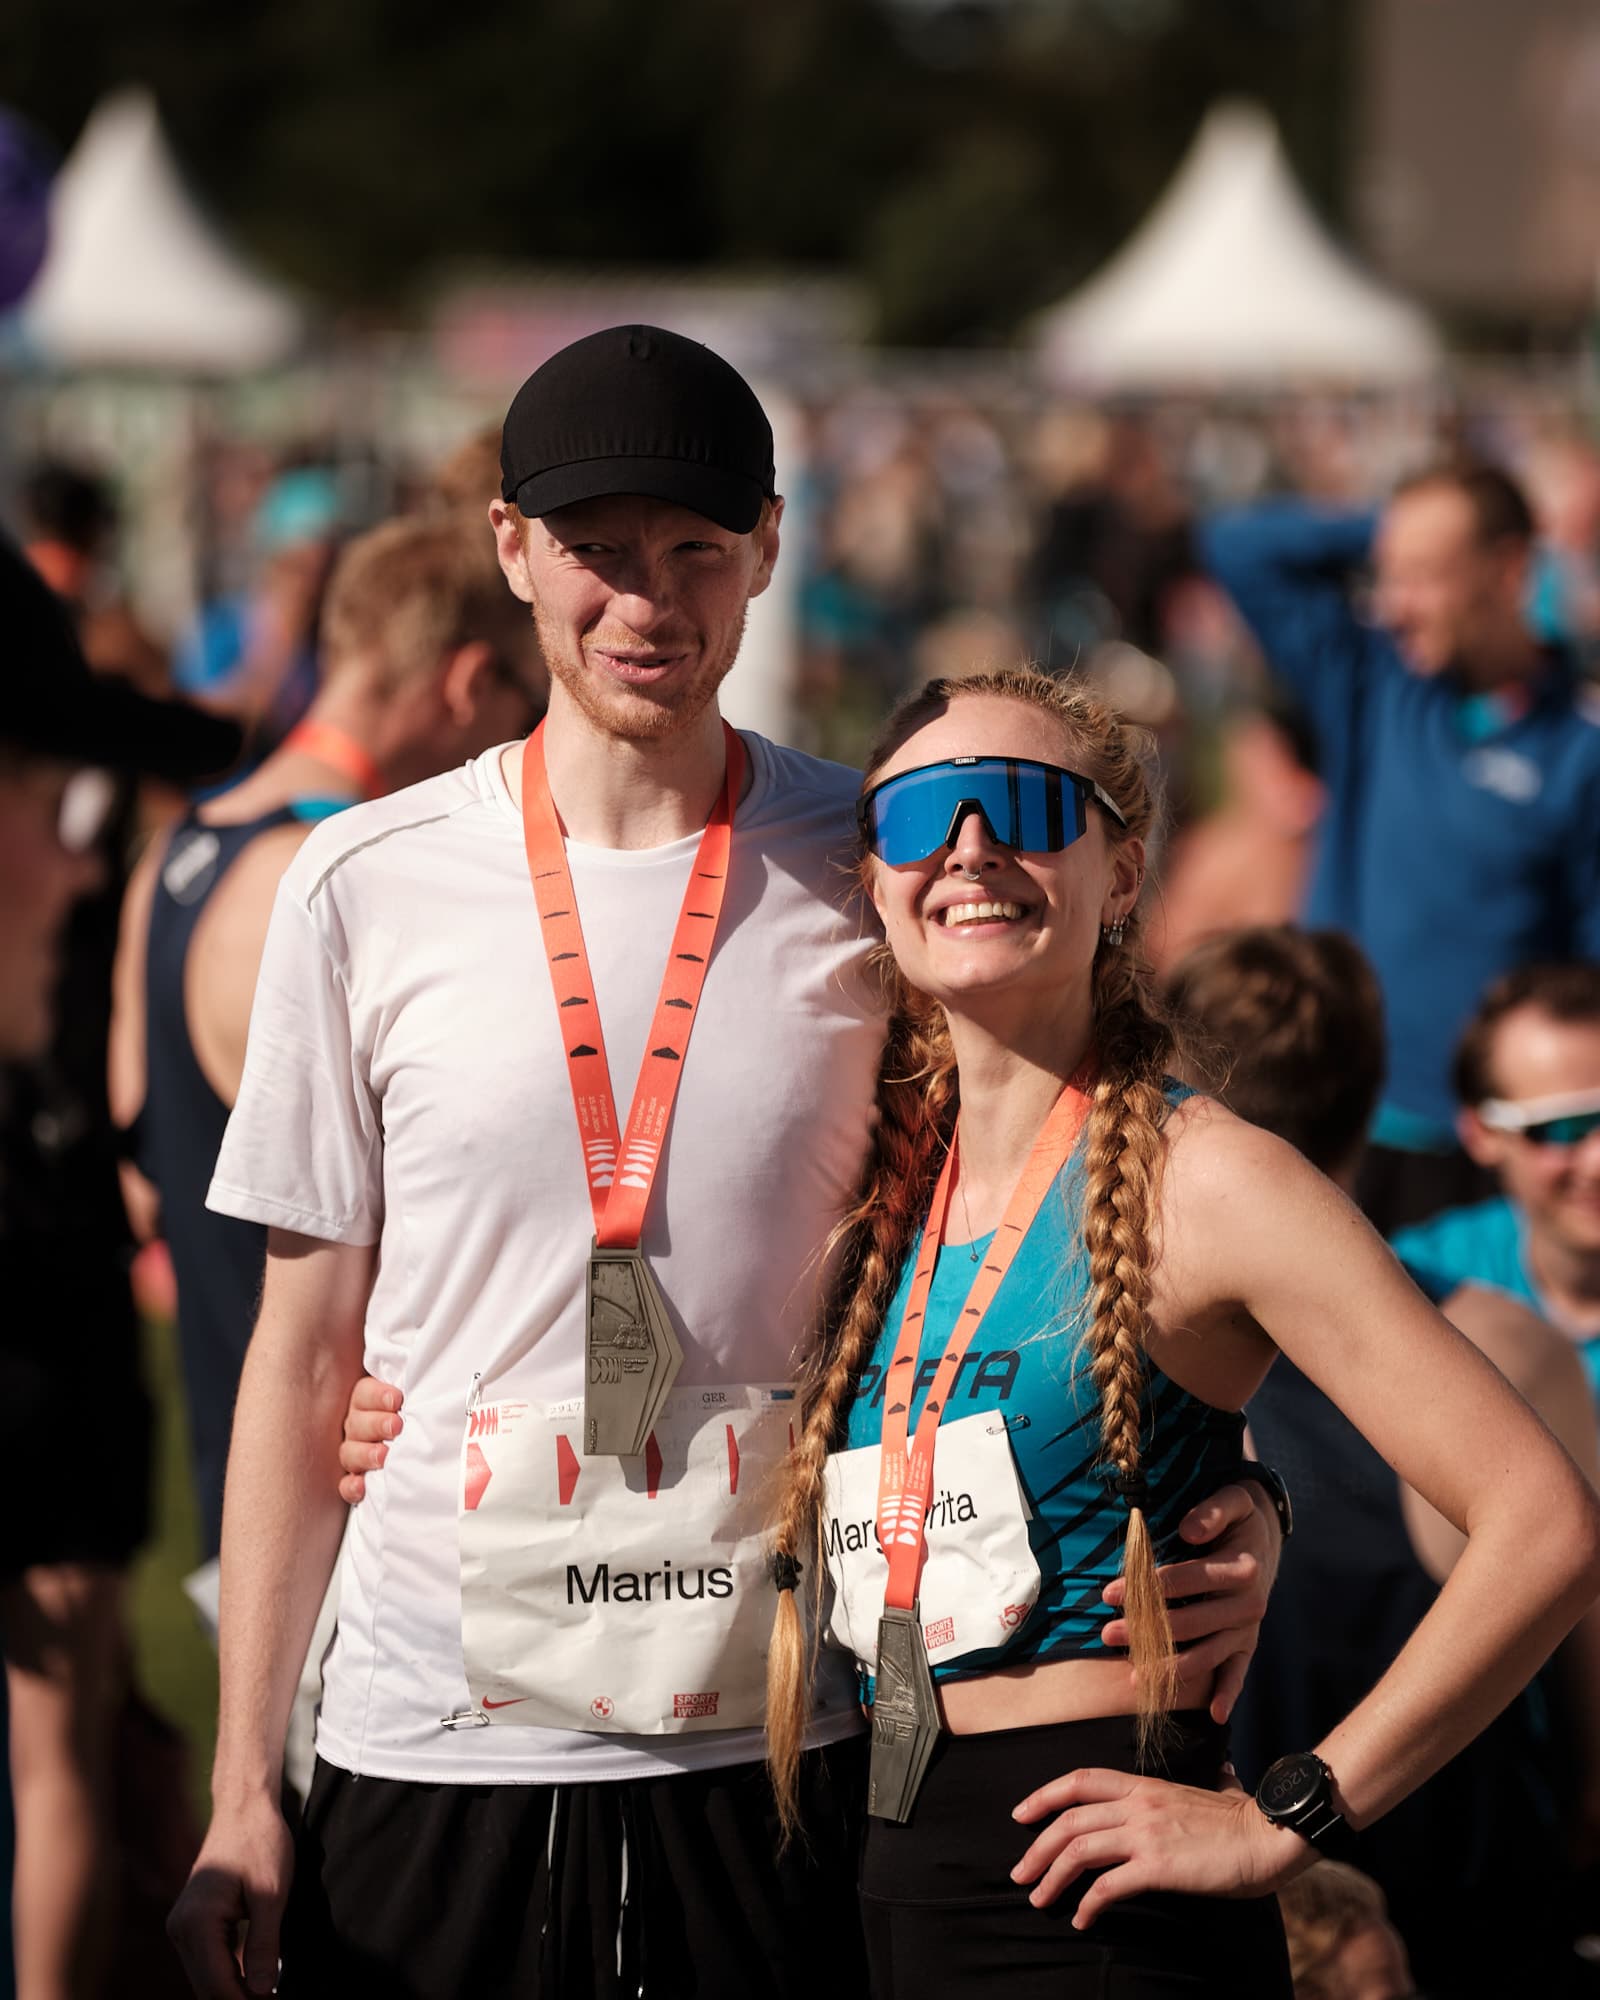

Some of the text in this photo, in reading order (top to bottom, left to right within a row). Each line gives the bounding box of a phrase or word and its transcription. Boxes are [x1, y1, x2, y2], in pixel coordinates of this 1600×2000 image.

[702, 1391, 728, 1403] GER
[566, 1560, 734, 1605] Marius
[926, 1618, 952, 1636] SPORTS
[928, 1631, 953, 1649] WORLD
[676, 1693, 718, 1705] SPORTS
[677, 1705, 715, 1717] WORLD
